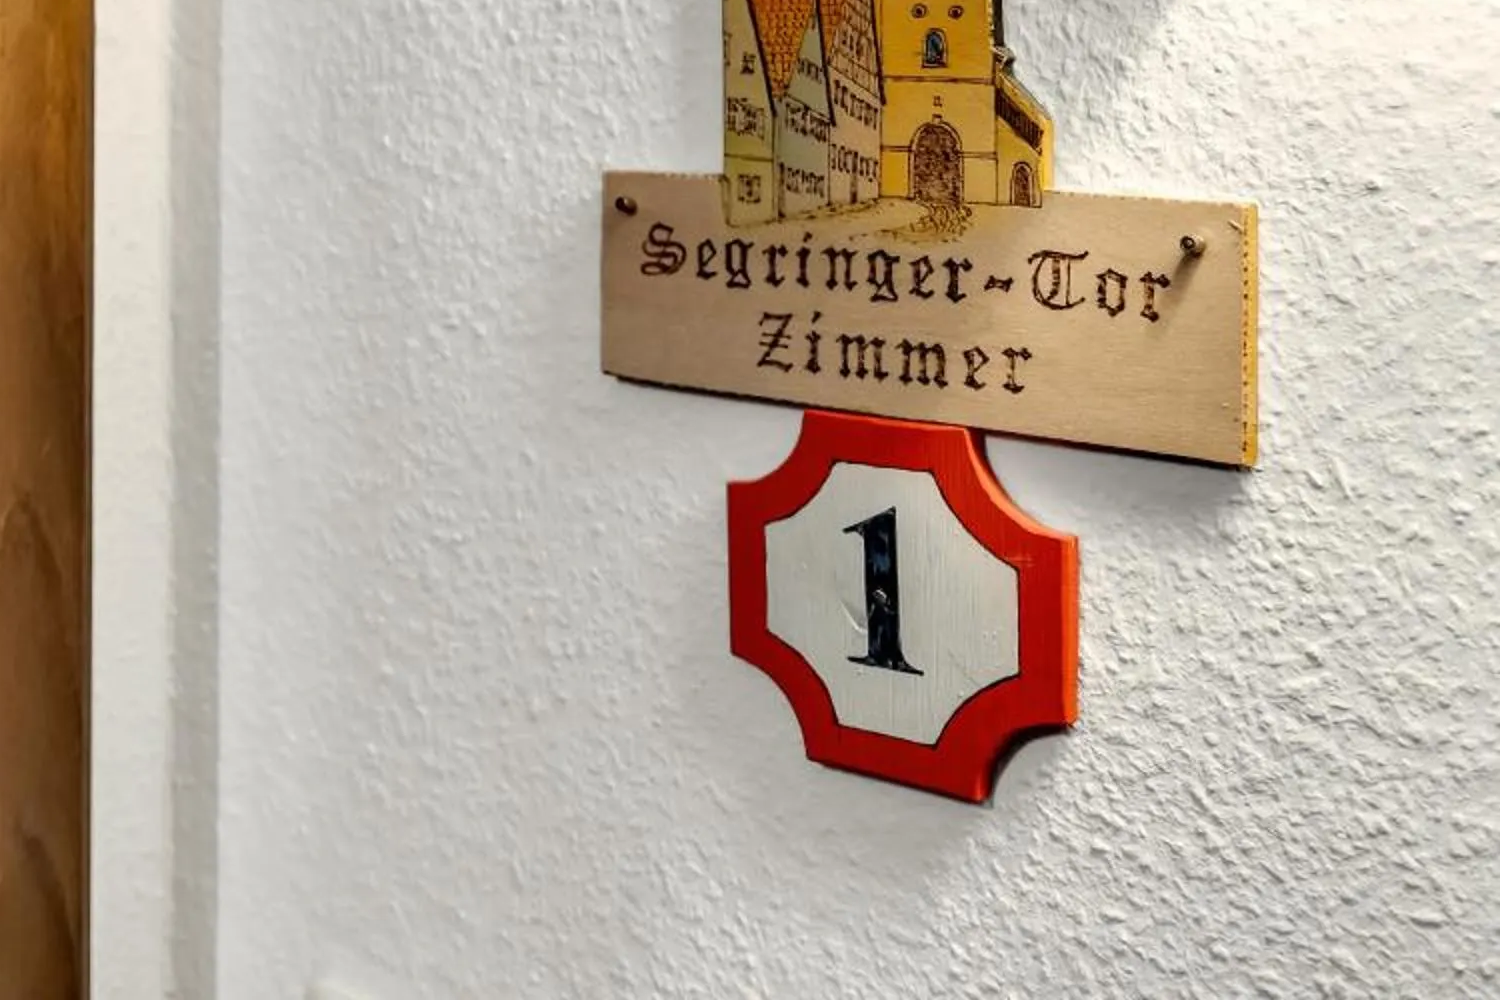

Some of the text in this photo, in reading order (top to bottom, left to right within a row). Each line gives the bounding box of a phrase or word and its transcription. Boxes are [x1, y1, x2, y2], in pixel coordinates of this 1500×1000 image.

[640, 221, 1172, 323] Segringer-Tor
[756, 309, 1033, 395] Zimmer
[842, 505, 925, 676] 1
